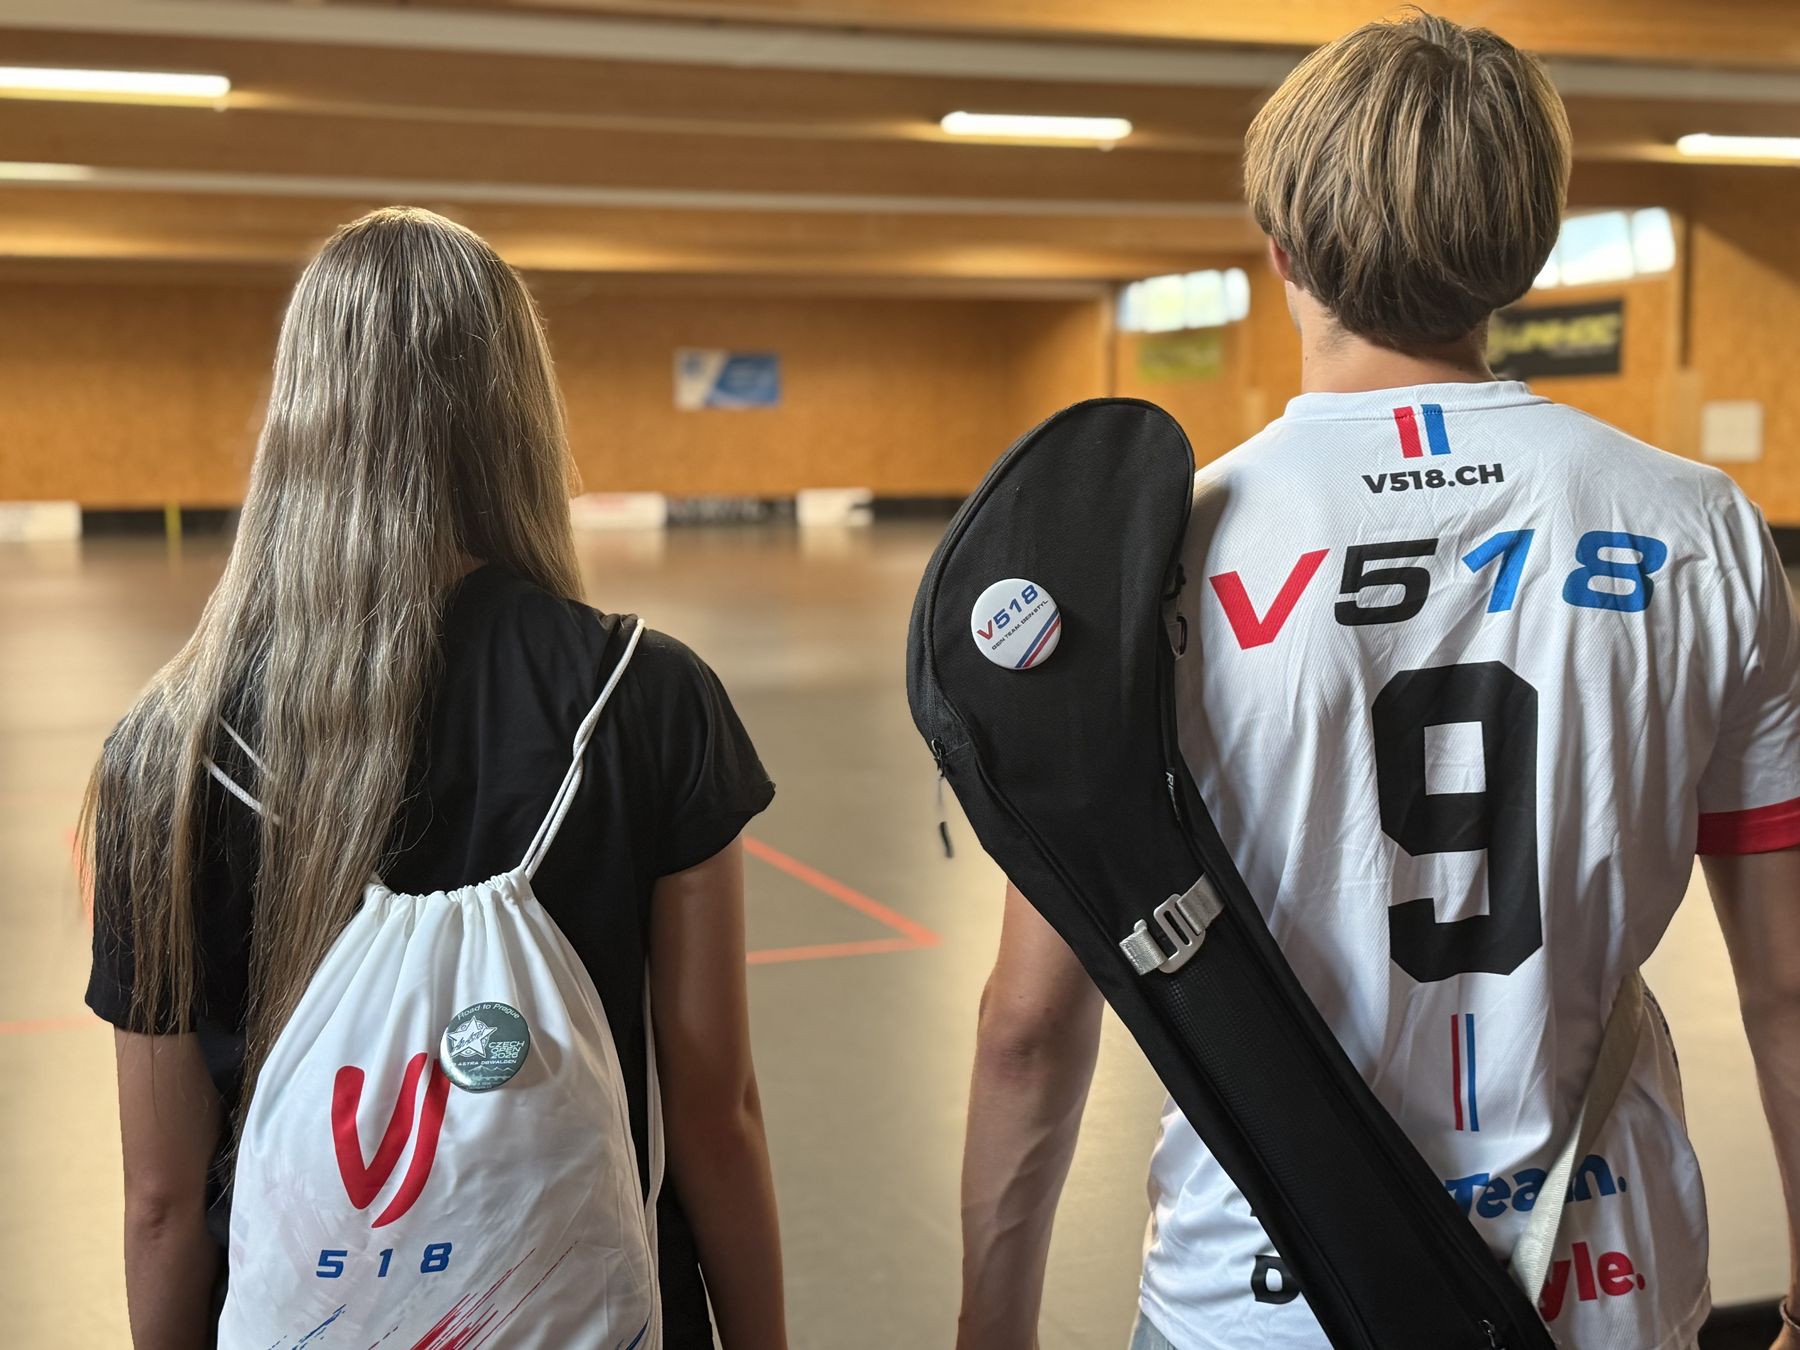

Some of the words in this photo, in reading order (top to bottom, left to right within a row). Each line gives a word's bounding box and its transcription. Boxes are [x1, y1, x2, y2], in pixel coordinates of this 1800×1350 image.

[1361, 463, 1505, 494] V518.CH
[977, 584, 1038, 640] V518
[1371, 660, 1543, 983] 9
[457, 1005, 480, 1020] Road
[493, 1003, 520, 1019] Prague
[489, 1040, 525, 1049] CZECH
[1538, 1241, 1646, 1322] yle.
